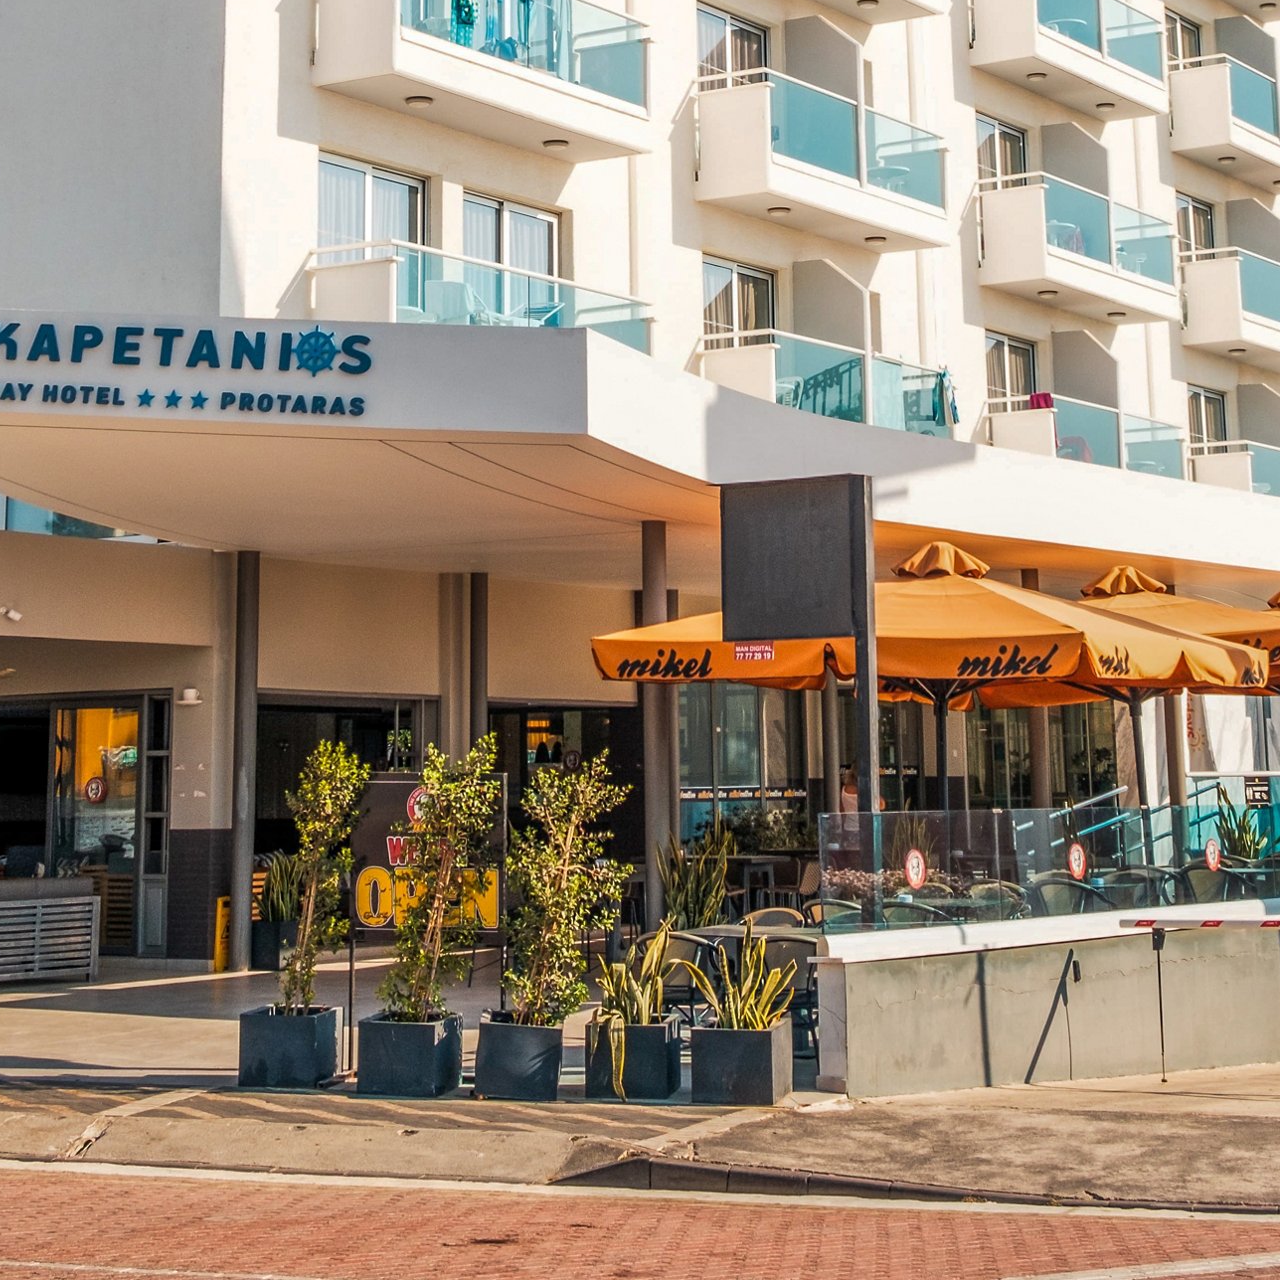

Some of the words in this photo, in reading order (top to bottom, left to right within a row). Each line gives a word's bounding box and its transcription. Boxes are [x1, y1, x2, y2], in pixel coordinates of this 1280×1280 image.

[42, 384, 125, 407] HOTEL
[220, 391, 366, 417] PROTARAS
[617, 648, 713, 679] mikel
[957, 644, 1059, 678] mikel
